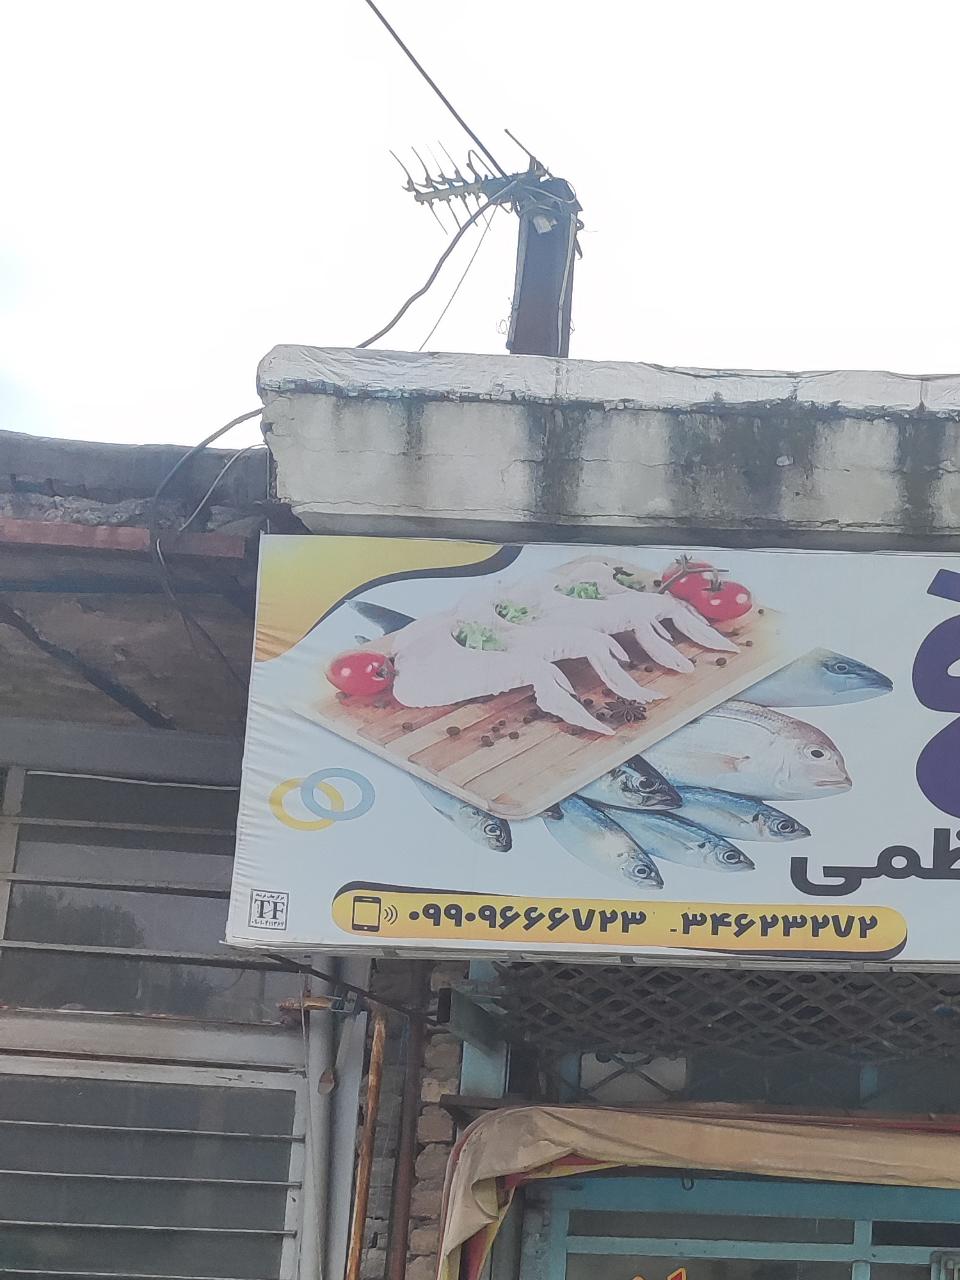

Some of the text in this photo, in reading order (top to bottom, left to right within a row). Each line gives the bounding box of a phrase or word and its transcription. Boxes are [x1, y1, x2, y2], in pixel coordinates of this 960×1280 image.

[254, 899, 285, 920] TF
[408, 902, 879, 939] ۰۹۹۰۹۶۶۶۷۲۳ ۳۴۶۲۳۲۷۲
